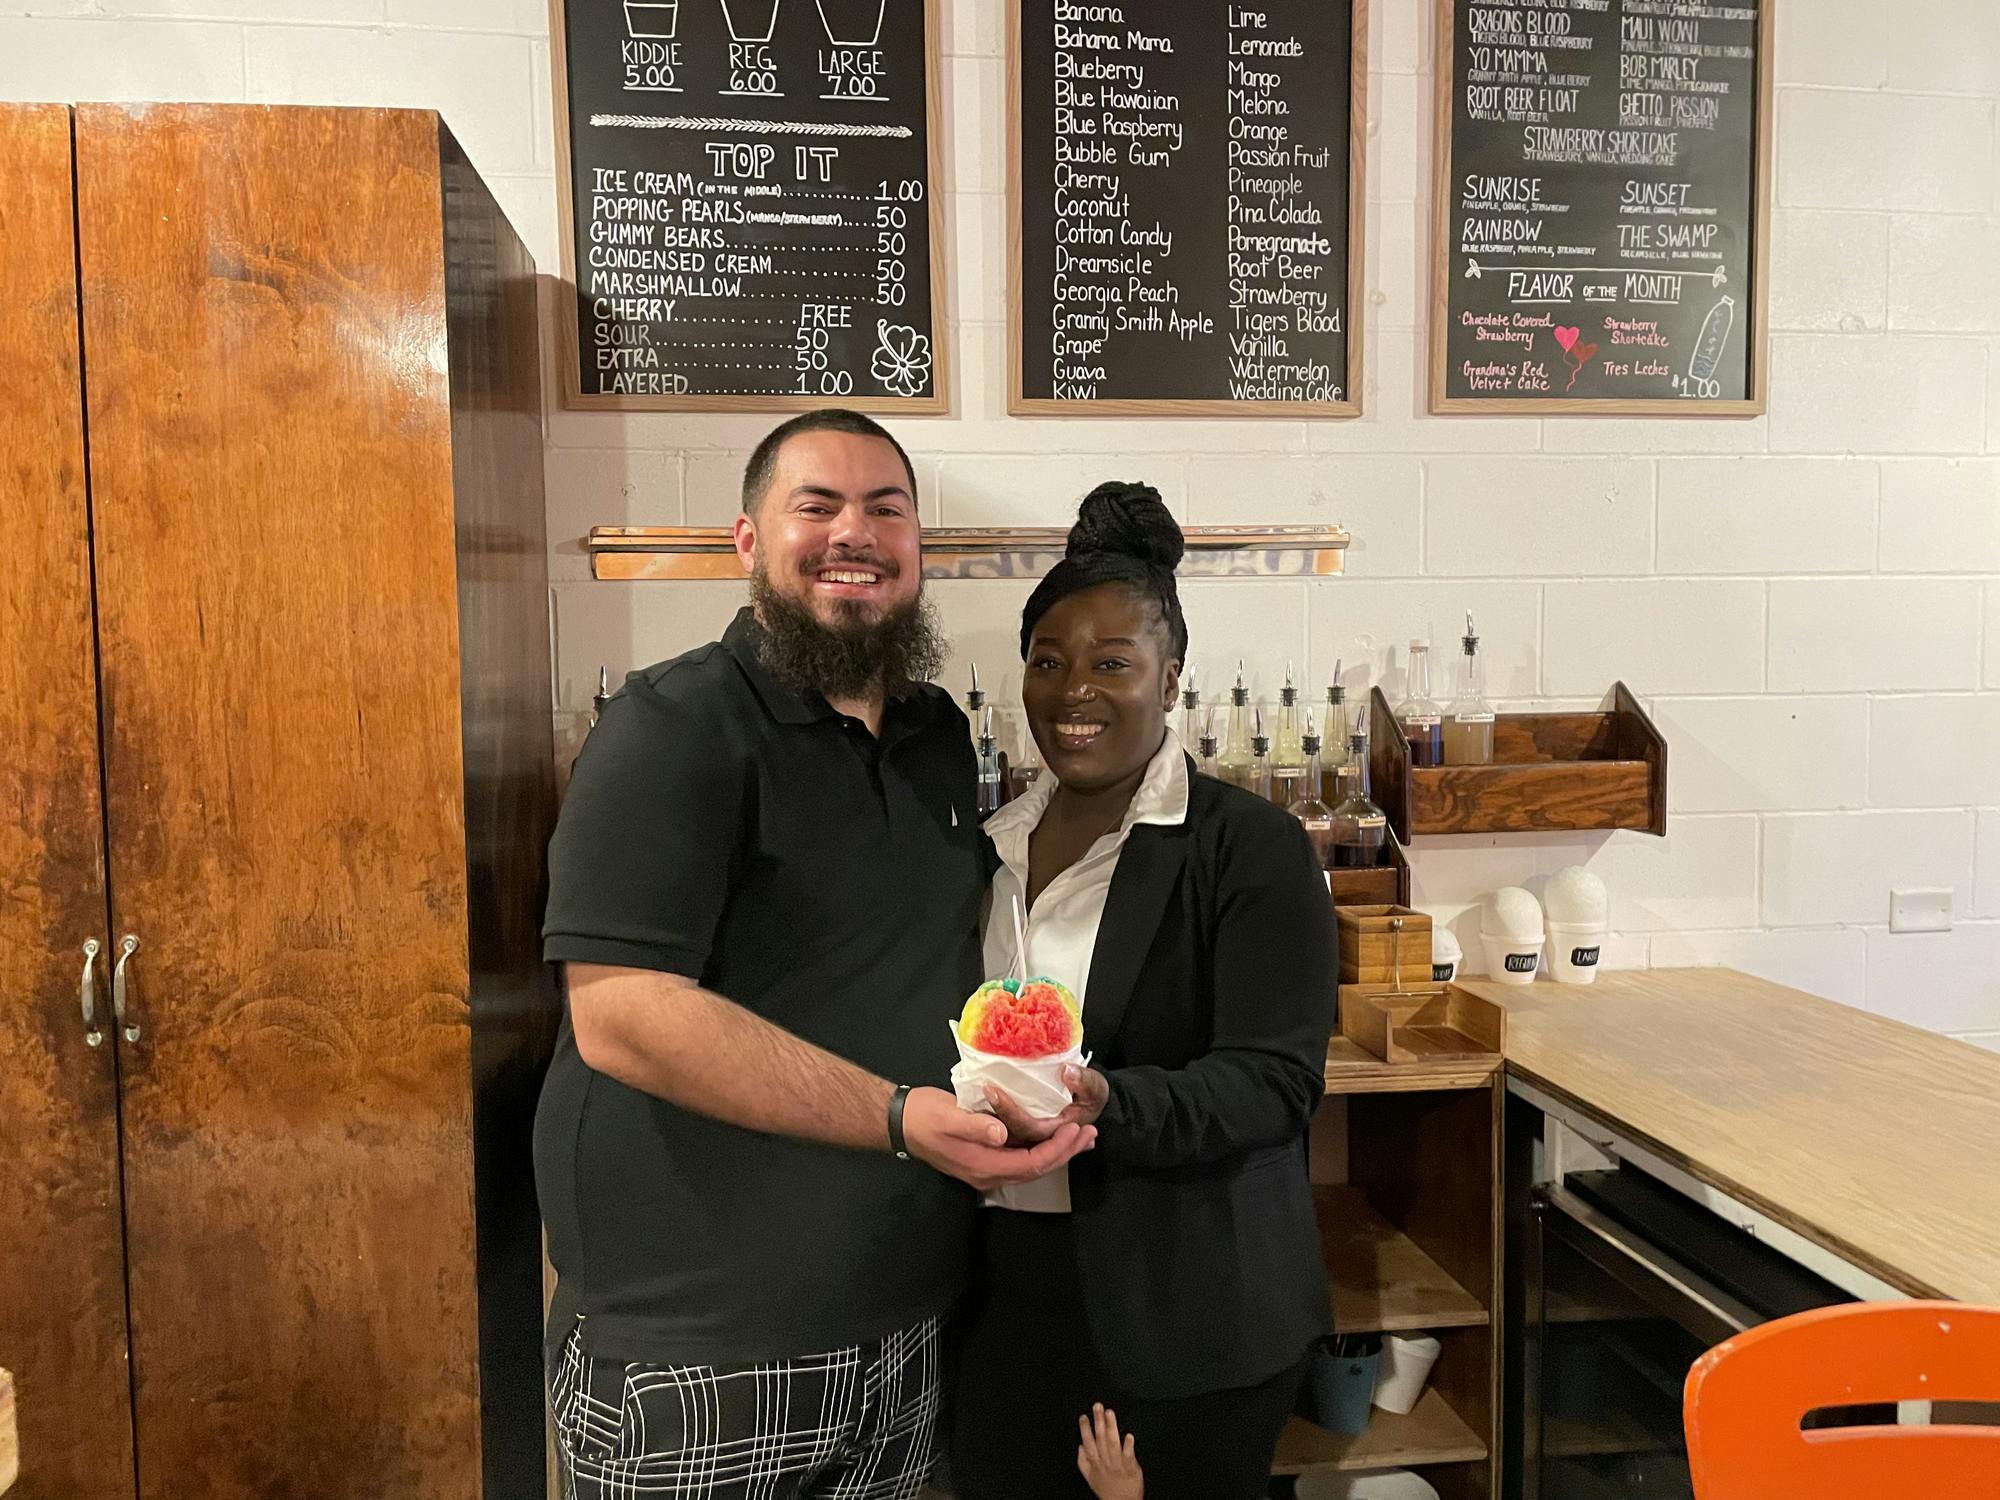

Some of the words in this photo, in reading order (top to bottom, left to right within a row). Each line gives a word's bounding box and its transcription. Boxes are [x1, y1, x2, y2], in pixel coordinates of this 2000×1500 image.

[1054, 0, 1125, 23] Banana
[1228, 4, 1267, 29] Lime
[1469, 8, 1522, 33] DRAGONS
[1526, 10, 1571, 35] BLOOD
[1054, 24, 1121, 50] Bahama
[1127, 31, 1174, 53] Mama
[1621, 16, 1653, 41] MAUI
[622, 41, 683, 66] KIDDIE
[730, 43, 777, 70] REG.
[1228, 32, 1304, 57] Lemonade
[818, 50, 886, 75] LARGE
[1054, 52, 1143, 89] Blueberry
[1468, 47, 1490, 71] YO
[1494, 48, 1548, 73] MAMMA
[1620, 54, 1648, 78] BOB
[1651, 56, 1699, 81] MARLEY
[624, 65, 675, 87] 5.00
[730, 71, 776, 92] 6.00
[827, 75, 876, 96] 7.00
[1228, 61, 1281, 97] Mango
[1054, 80, 1095, 107] Blue
[1101, 86, 1179, 111] Hawaiian
[1228, 89, 1290, 115] Melona
[1467, 86, 1501, 110] ROOT
[1504, 87, 1533, 111] BEER
[1539, 89, 1579, 113] FLOAT
[1620, 92, 1663, 117] GHETTO
[1670, 95, 1719, 119] PASSION
[1054, 107, 1096, 135] Blue
[1103, 112, 1183, 150] Raspberry
[1527, 111, 1549, 122] BEER
[1229, 116, 1288, 151] Orange
[1523, 126, 1604, 151] STRAWBERRY
[705, 142, 775, 179] TOP
[795, 146, 839, 182] IT
[1054, 137, 1117, 163] Bubble
[1129, 142, 1169, 168] Gum
[1229, 141, 1290, 167] Passion
[1294, 145, 1330, 168] Fruit
[592, 167, 628, 195] ICE
[634, 172, 694, 196] CREAM
[717, 185, 738, 195] THE
[874, 180, 923, 201] 1.00
[1054, 163, 1119, 200] Cherry
[1228, 168, 1303, 201] Pineapple
[1463, 174, 1541, 201] SUNRISE
[1620, 180, 1692, 206] SUNSET
[592, 195, 674, 222] POPPING
[682, 200, 745, 224] PEARLS
[1054, 188, 1129, 217] Coconut
[1228, 195, 1266, 223] Pina
[1269, 197, 1322, 224] Colada
[590, 225, 655, 246] GUMMY
[664, 227, 725, 249] BEARS
[1055, 219, 1113, 245] Cotton
[1120, 221, 1172, 257] Candy
[1228, 225, 1331, 261] Pomegranate
[1462, 218, 1542, 242] RAINBOW
[1617, 225, 1651, 248] THE
[1656, 223, 1718, 248] SWAMP
[589, 245, 705, 273] CONDENSED
[714, 255, 772, 275] CREAM
[1055, 245, 1152, 274] Dreamsicle
[1229, 254, 1269, 279] Root
[1278, 255, 1323, 279] Beer
[591, 271, 741, 298] MARSHMALLOW
[1053, 273, 1122, 313] Georgia
[1128, 277, 1178, 303] Peach
[1228, 279, 1328, 313] Strawberry
[1508, 272, 1574, 298] FLAVOR
[1583, 285, 1597, 298] OF
[1598, 286, 1618, 299] THE
[1624, 274, 1682, 299] MONTH
[592, 297, 676, 322] CHERRY
[801, 304, 852, 328] FREE
[1053, 304, 1110, 341] Granny
[1115, 306, 1162, 332] Smith
[1169, 308, 1214, 341] Apple
[1228, 304, 1289, 341] Tigers
[1297, 307, 1341, 333] Blood
[1462, 311, 1510, 327] Chocolate
[1512, 313, 1555, 328] Covered
[593, 324, 651, 346] SOUR
[1476, 328, 1534, 351] Strawberry
[1604, 317, 1658, 336] Strawberry
[1611, 331, 1669, 347] Shortcake
[1053, 331, 1103, 361] Grape
[1228, 332, 1289, 357] Vanilla
[596, 348, 659, 370] EXTRA
[1053, 358, 1107, 380] Guava
[1229, 356, 1330, 382] Watermelon
[1463, 361, 1516, 377] Grandma's
[1521, 361, 1549, 377] Red
[1604, 361, 1628, 376] Tres
[1634, 360, 1669, 376] Leches
[599, 373, 688, 395] LAYERED
[794, 370, 853, 395] 1.00
[1053, 381, 1097, 400] Kiwi
[1229, 380, 1303, 400] Wedding
[1306, 382, 1342, 401] Cake
[1470, 375, 1512, 390] Velvet
[1517, 376, 1550, 391] Cake
